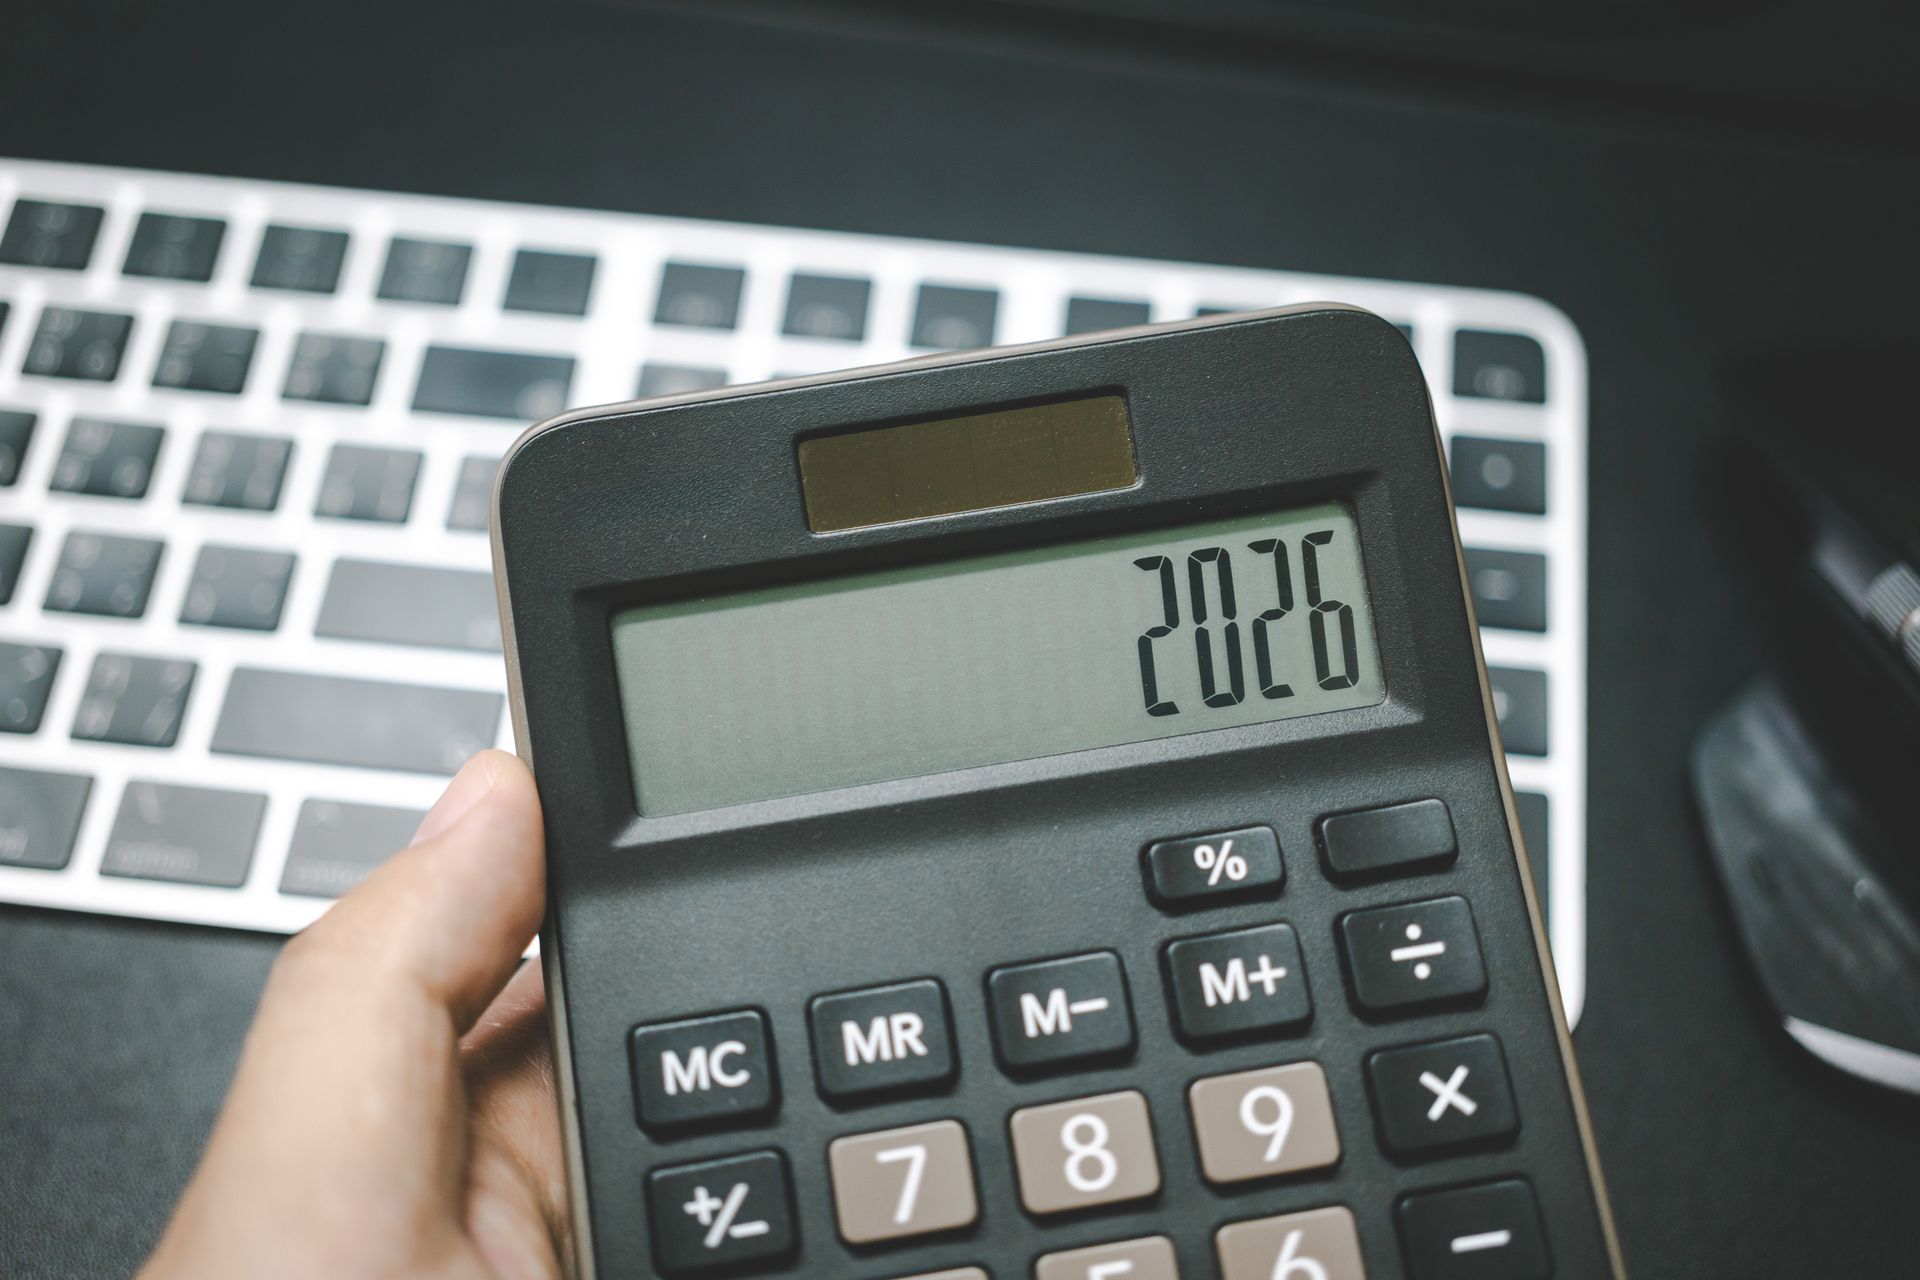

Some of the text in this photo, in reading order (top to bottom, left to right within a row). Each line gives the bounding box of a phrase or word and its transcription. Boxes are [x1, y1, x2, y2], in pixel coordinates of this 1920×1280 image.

[1133, 530, 1359, 717] 2026
[1194, 841, 1249, 887] %
[1199, 954, 1287, 1007] M+
[661, 1040, 750, 1095] MC
[842, 1012, 928, 1066] MR
[1061, 1113, 1120, 1193] 8
[1239, 1085, 1294, 1162] 9
[875, 1144, 928, 1225] 7
